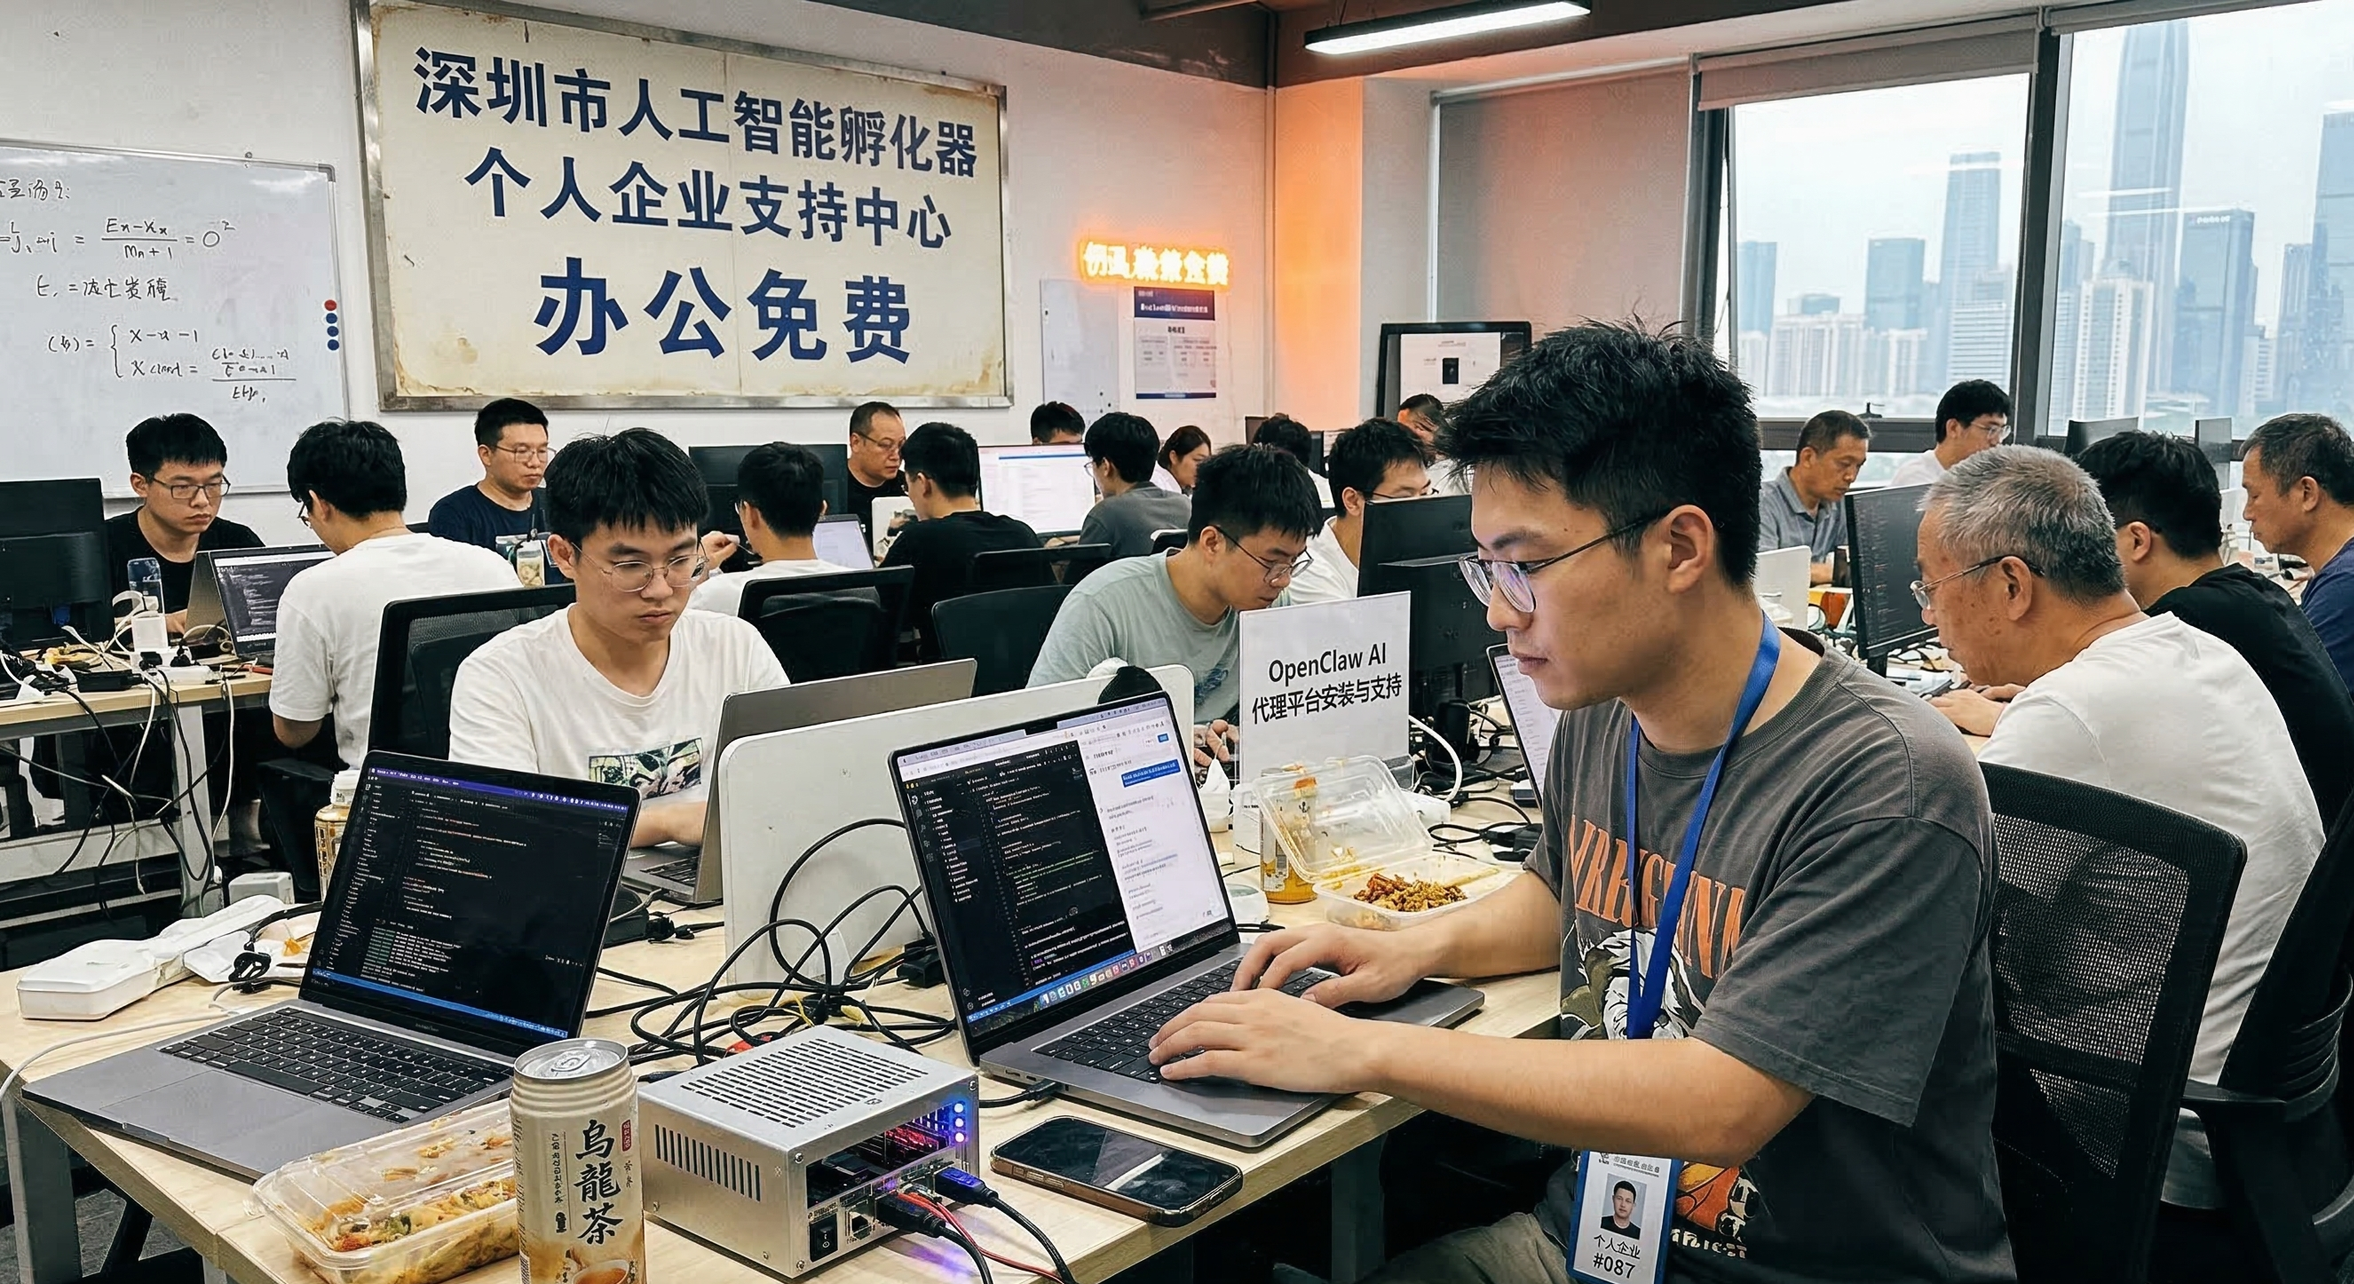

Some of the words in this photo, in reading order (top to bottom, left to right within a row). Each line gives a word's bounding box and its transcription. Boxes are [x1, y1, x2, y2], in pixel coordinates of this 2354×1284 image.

[413, 46, 977, 178] 深圳市人工智能孵化器
[464, 146, 952, 249] 个人企业支持中心
[533, 256, 910, 365] 办公免费
[1268, 649, 1363, 687] OpenClaw
[1367, 642, 1386, 666] AI
[1251, 671, 1402, 725] 代理平台安装与支持
[1593, 1234, 1641, 1259] 个人企业
[1593, 1252, 1636, 1279] #087
